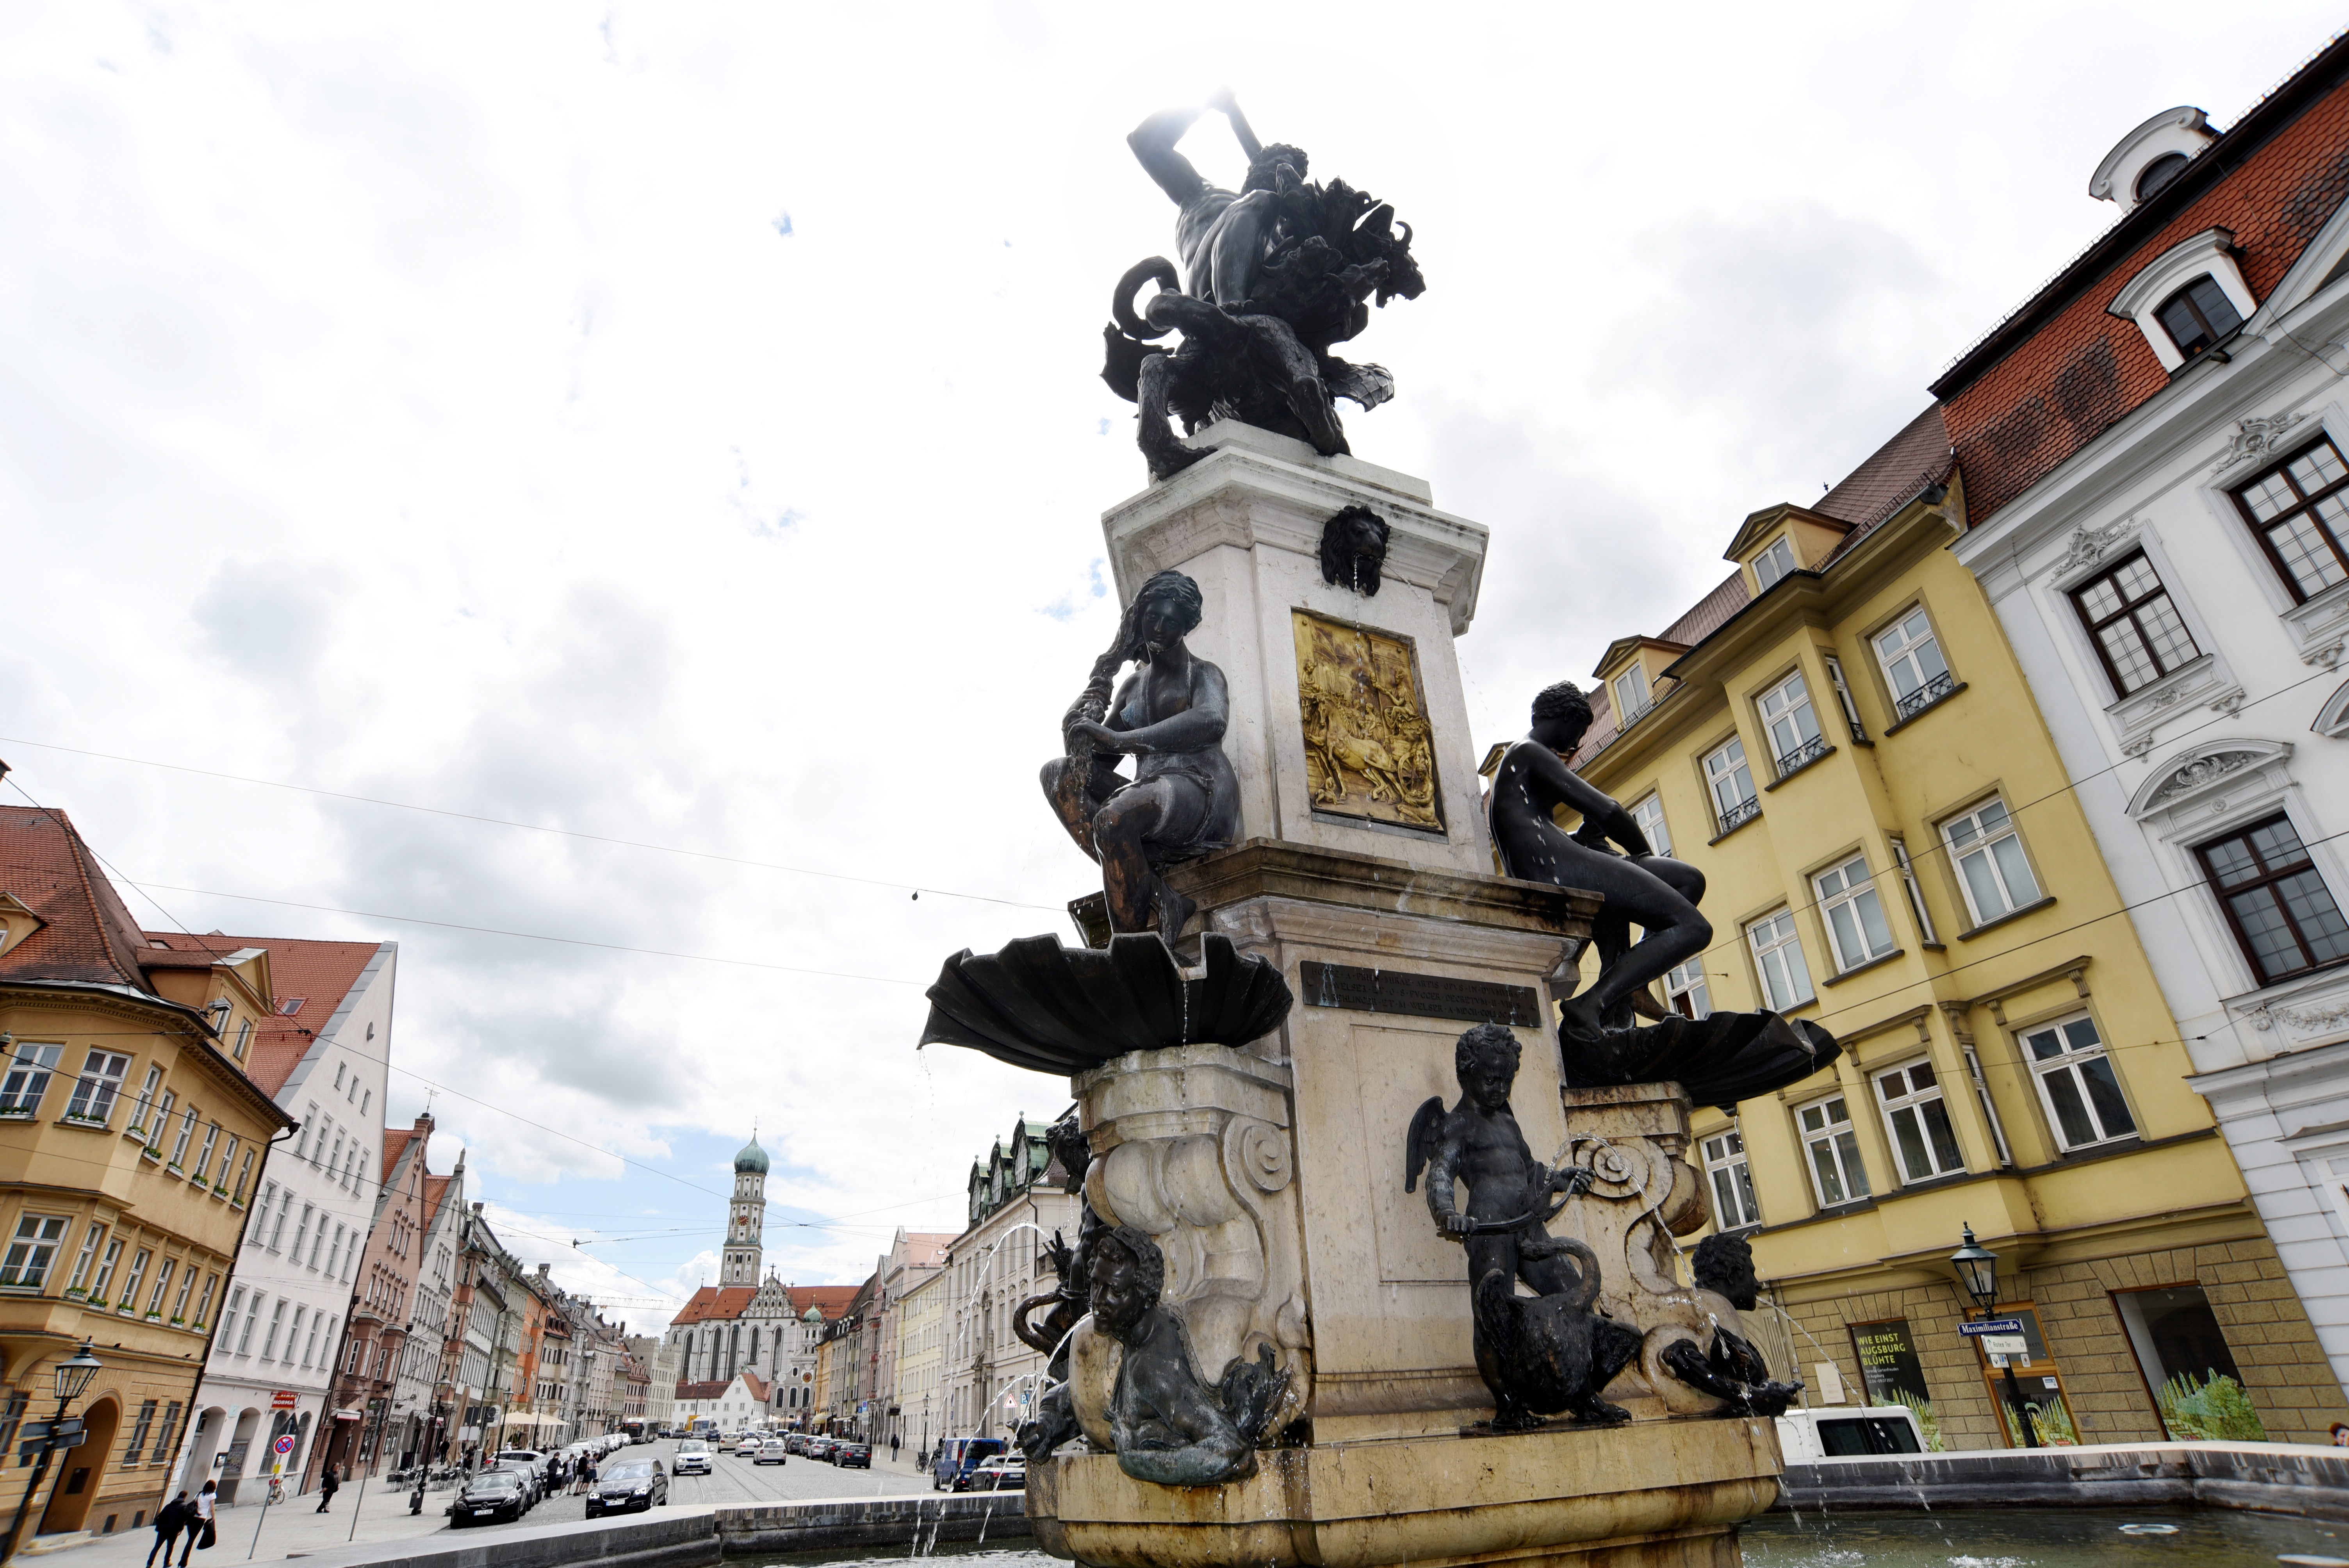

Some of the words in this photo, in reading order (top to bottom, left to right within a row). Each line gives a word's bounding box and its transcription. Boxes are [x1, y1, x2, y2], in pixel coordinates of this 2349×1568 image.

[1416, 980, 1439, 989] ARTIS
[1444, 982, 1464, 992] OPVS
[1445, 994, 1488, 1005] DECRETVM
[1410, 1001, 1443, 1012] WELSER
[1961, 1321, 2018, 1333] Maximilianstraße
[1857, 1336, 1873, 1345] WIE
[1875, 1333, 1898, 1344] EINST
[1861, 1343, 1906, 1356] AUGSBURG
[1862, 1354, 1895, 1366] BLÜHTE
